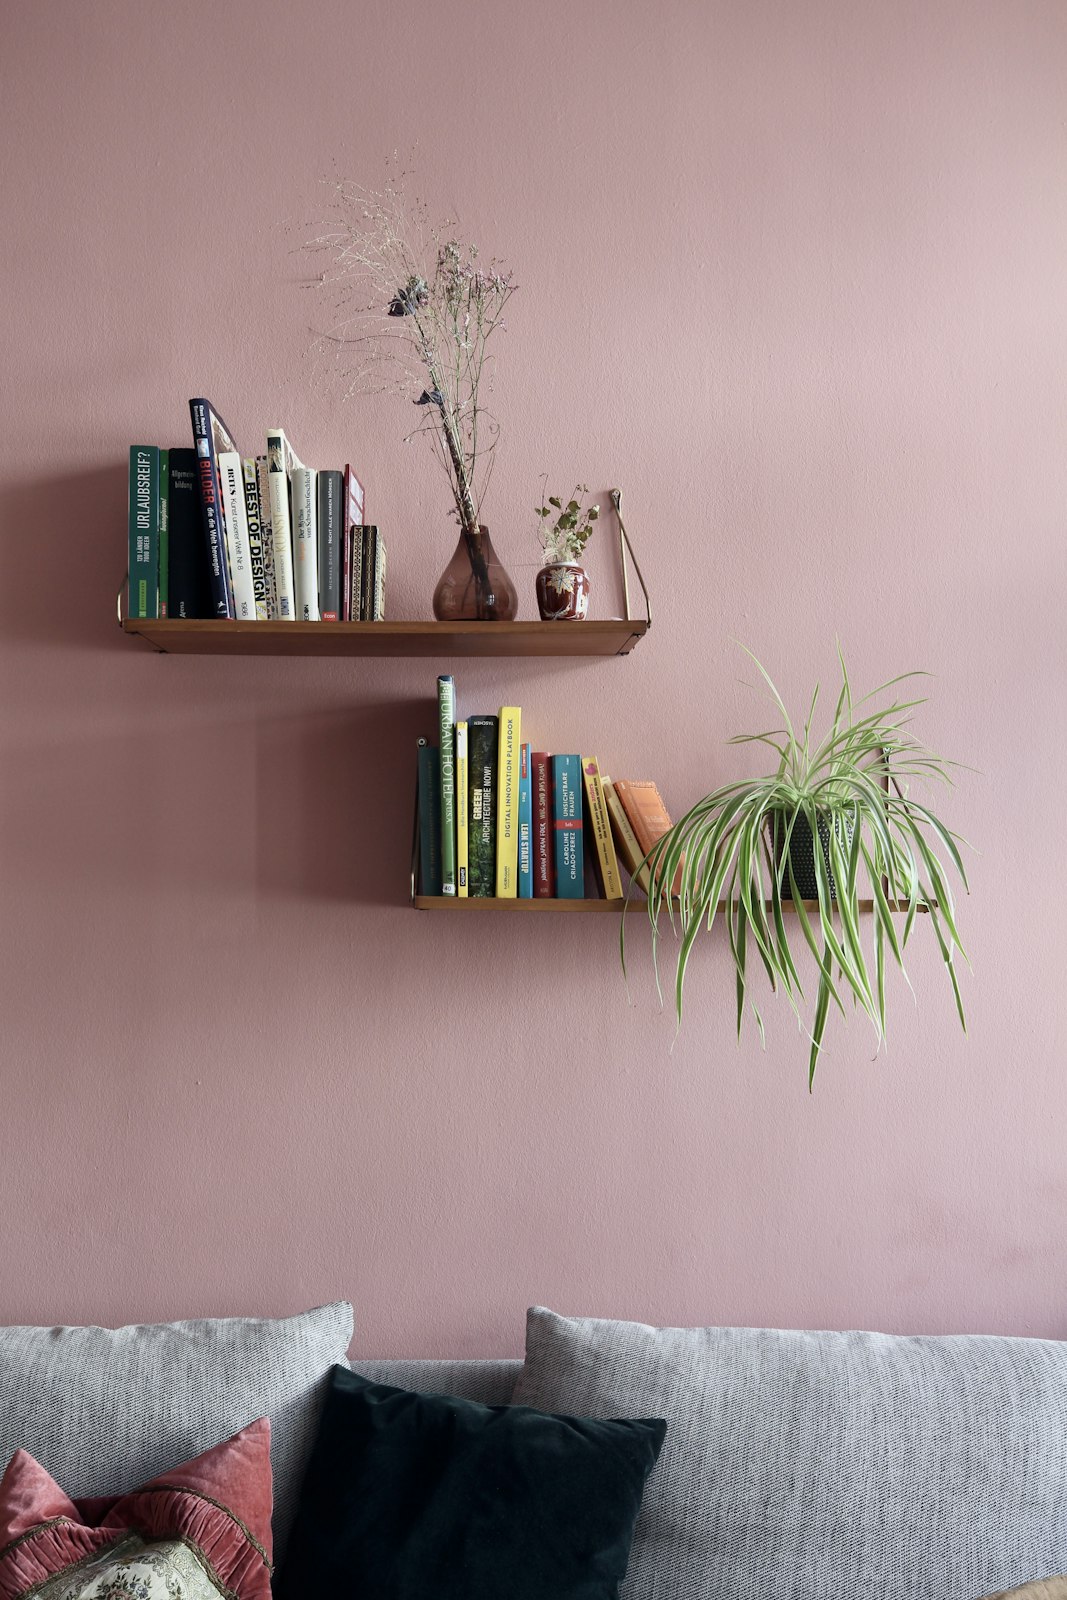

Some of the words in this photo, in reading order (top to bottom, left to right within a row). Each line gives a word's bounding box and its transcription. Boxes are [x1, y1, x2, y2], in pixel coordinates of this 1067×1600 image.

[137, 452, 151, 529] URLAUBSREIF?
[200, 460, 215, 504] BILDER
[206, 507, 214, 517] die
[230, 498, 238, 516] Kunst
[246, 482, 258, 520] BEST
[208, 518, 216, 528] die
[232, 516, 240, 540] unserer
[249, 522, 260, 541] OF
[273, 513, 286, 553] KUNST
[298, 509, 306, 528] Mythos
[209, 529, 218, 544] Welt
[210, 545, 220, 576] bewegten
[250, 546, 265, 602] DESIGN
[441, 703, 453, 750] URBAN
[442, 755, 453, 798] HOTEL
[483, 766, 491, 786] NOW!
[473, 788, 483, 820] GREEN
[483, 788, 492, 843] ARCHITECTURE
[520, 823, 529, 841] LEAN
[521, 841, 529, 873] STARTUP
